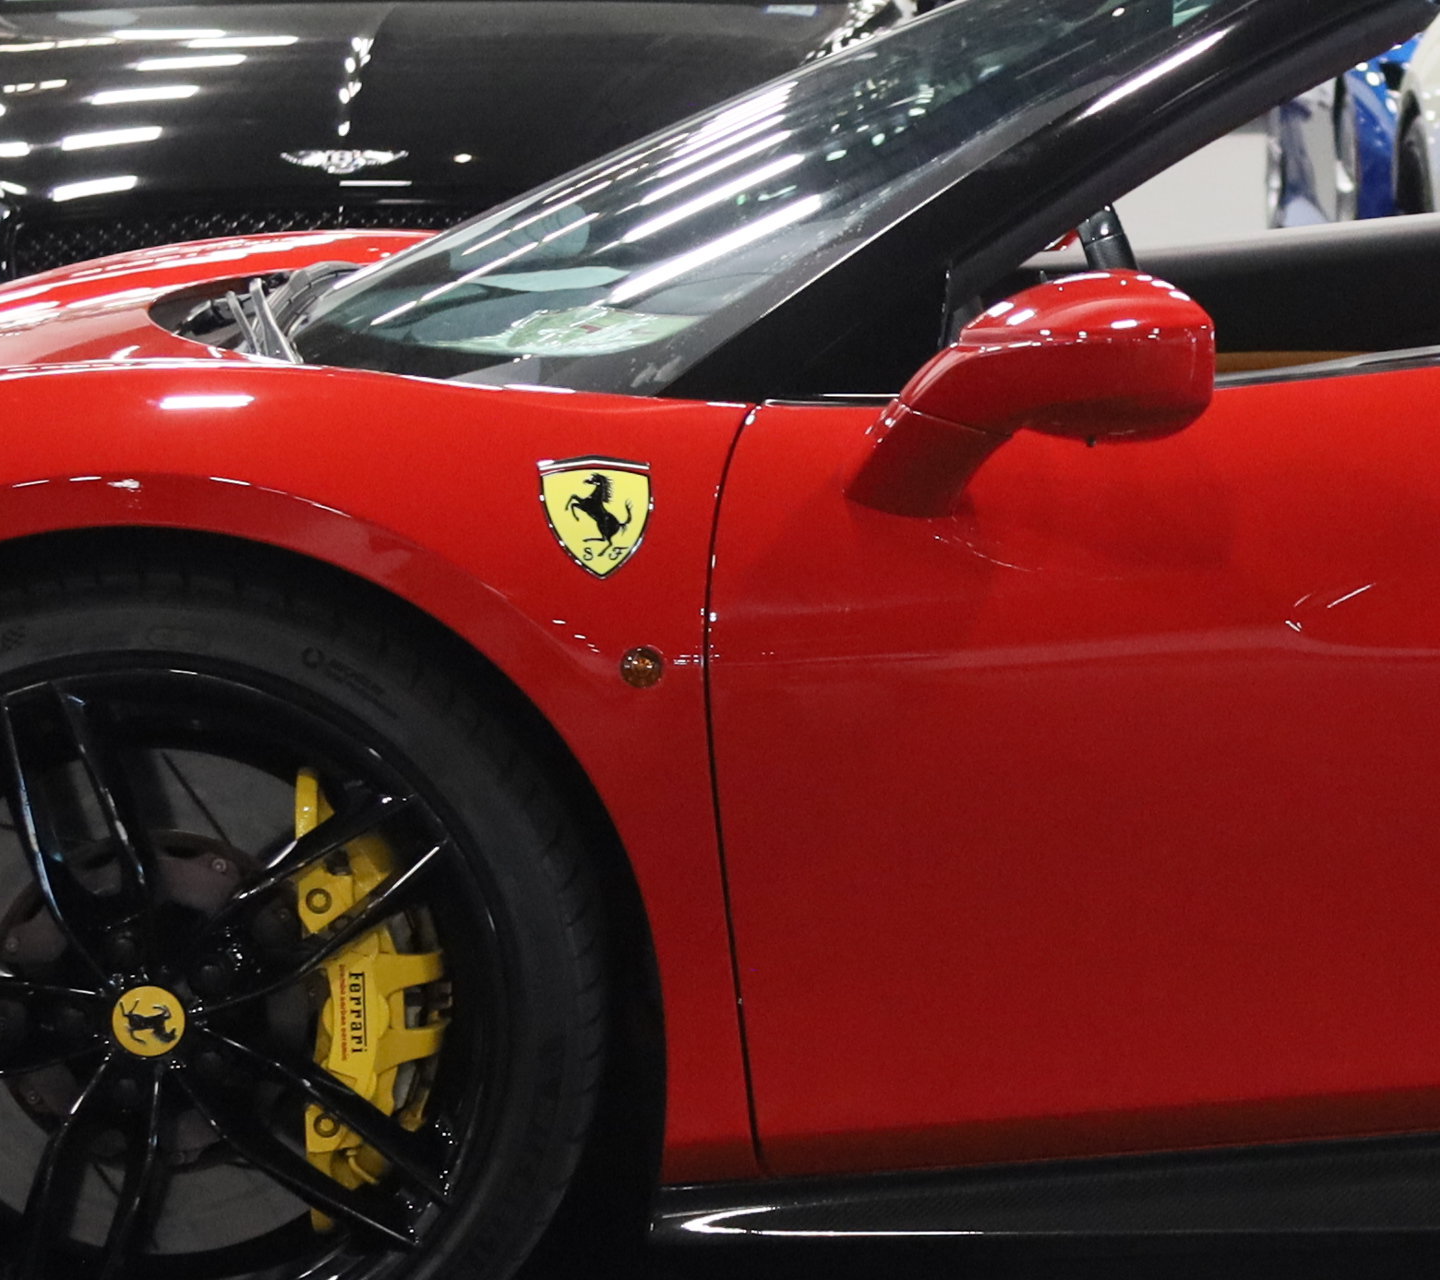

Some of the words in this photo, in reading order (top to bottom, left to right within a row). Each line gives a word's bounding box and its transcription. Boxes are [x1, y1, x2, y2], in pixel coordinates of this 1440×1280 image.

[583, 546, 594, 561] S
[608, 546, 629, 561] F
[349, 970, 368, 1054] Ferrari
